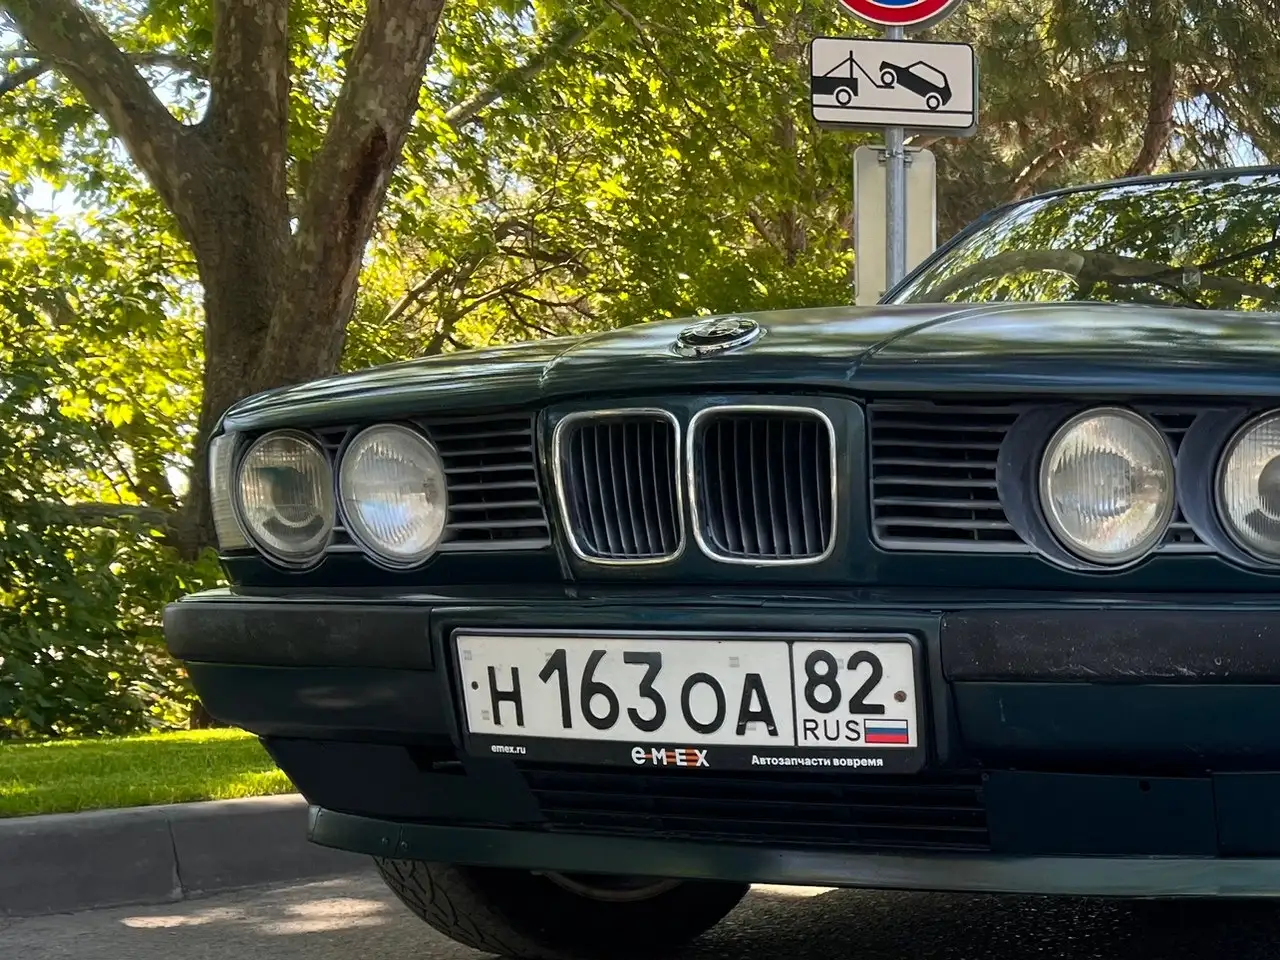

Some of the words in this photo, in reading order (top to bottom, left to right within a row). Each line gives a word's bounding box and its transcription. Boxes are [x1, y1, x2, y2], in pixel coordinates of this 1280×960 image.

[804, 650, 885, 715] 82
[803, 719, 861, 742] RUS
[491, 744, 526, 755] emex.ru
[751, 755, 831, 768] Автозапчасти
[833, 757, 883, 769] вовремя
